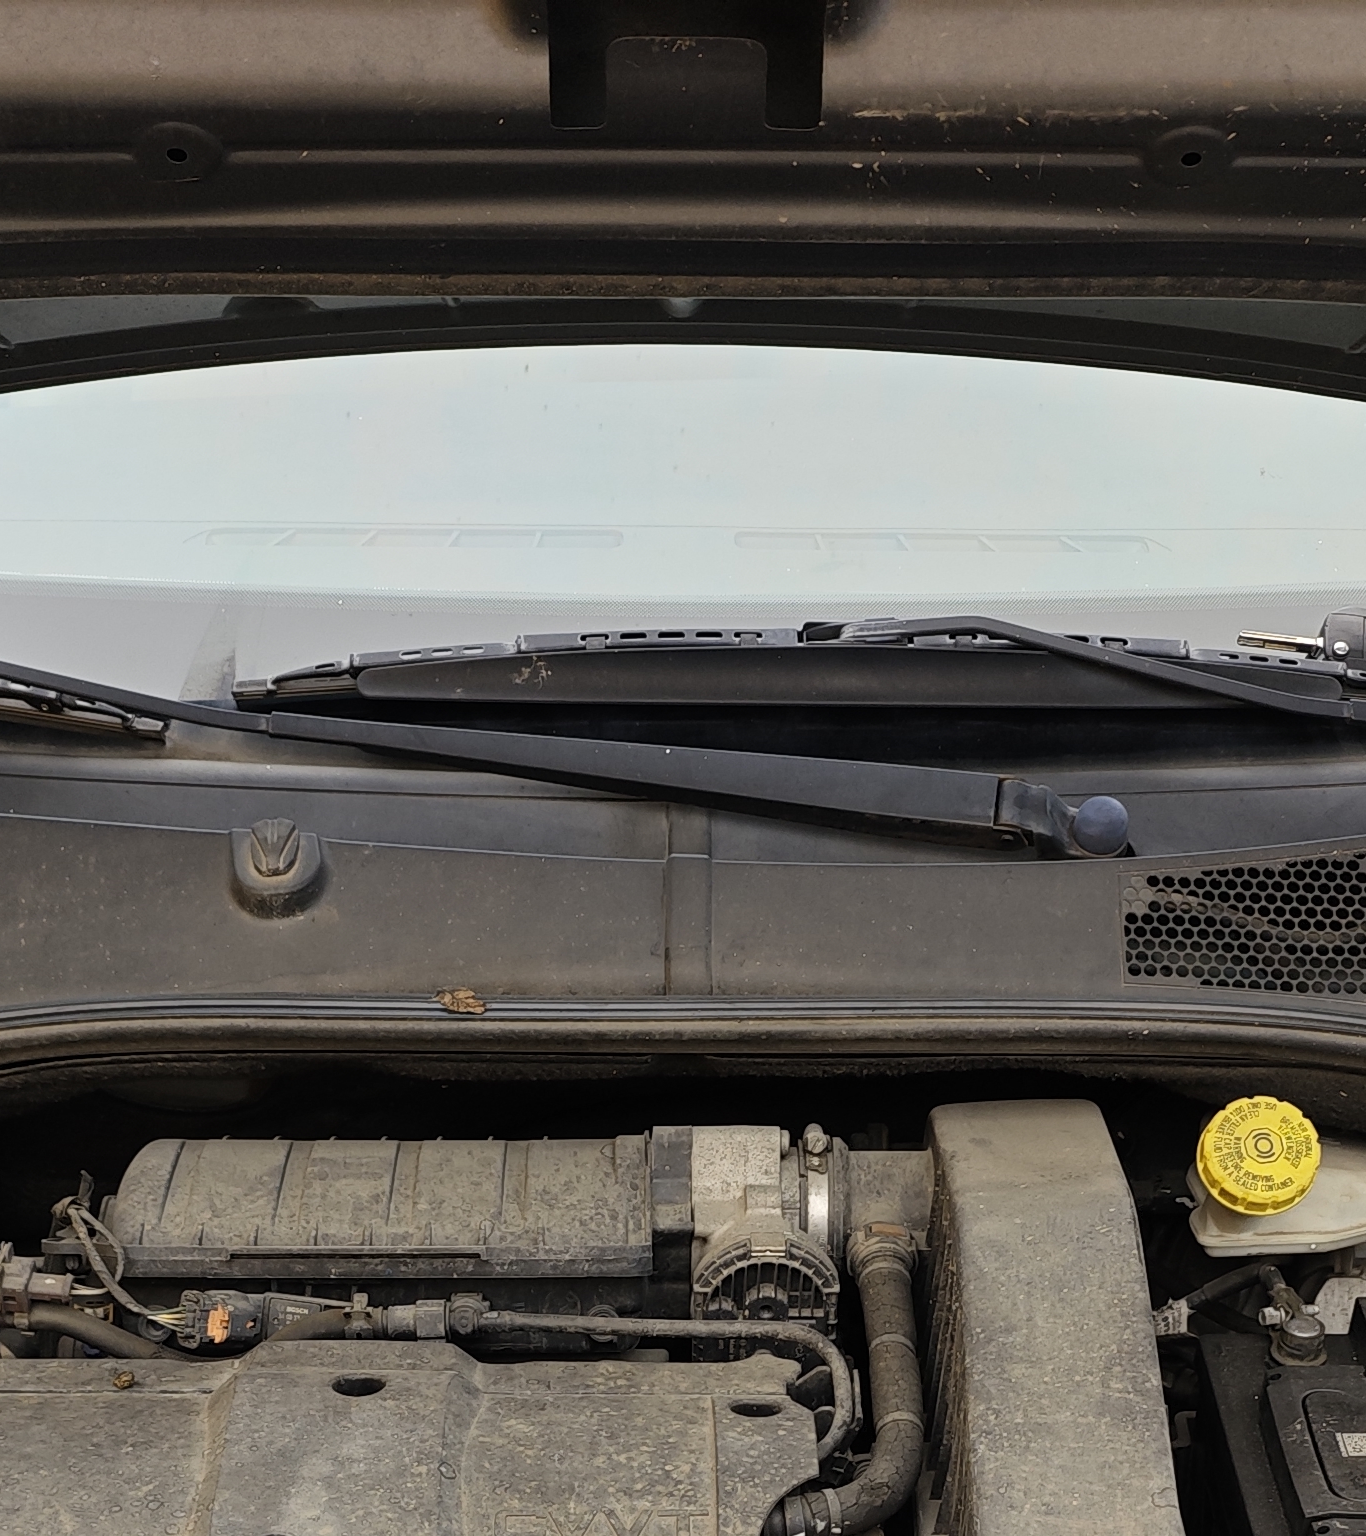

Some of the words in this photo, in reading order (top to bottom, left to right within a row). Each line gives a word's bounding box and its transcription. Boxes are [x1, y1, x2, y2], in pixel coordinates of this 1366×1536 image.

[1264, 1101, 1277, 1111] USE
[1233, 1174, 1258, 1192] SEALED
[1260, 1176, 1296, 1192] CONTAINER
